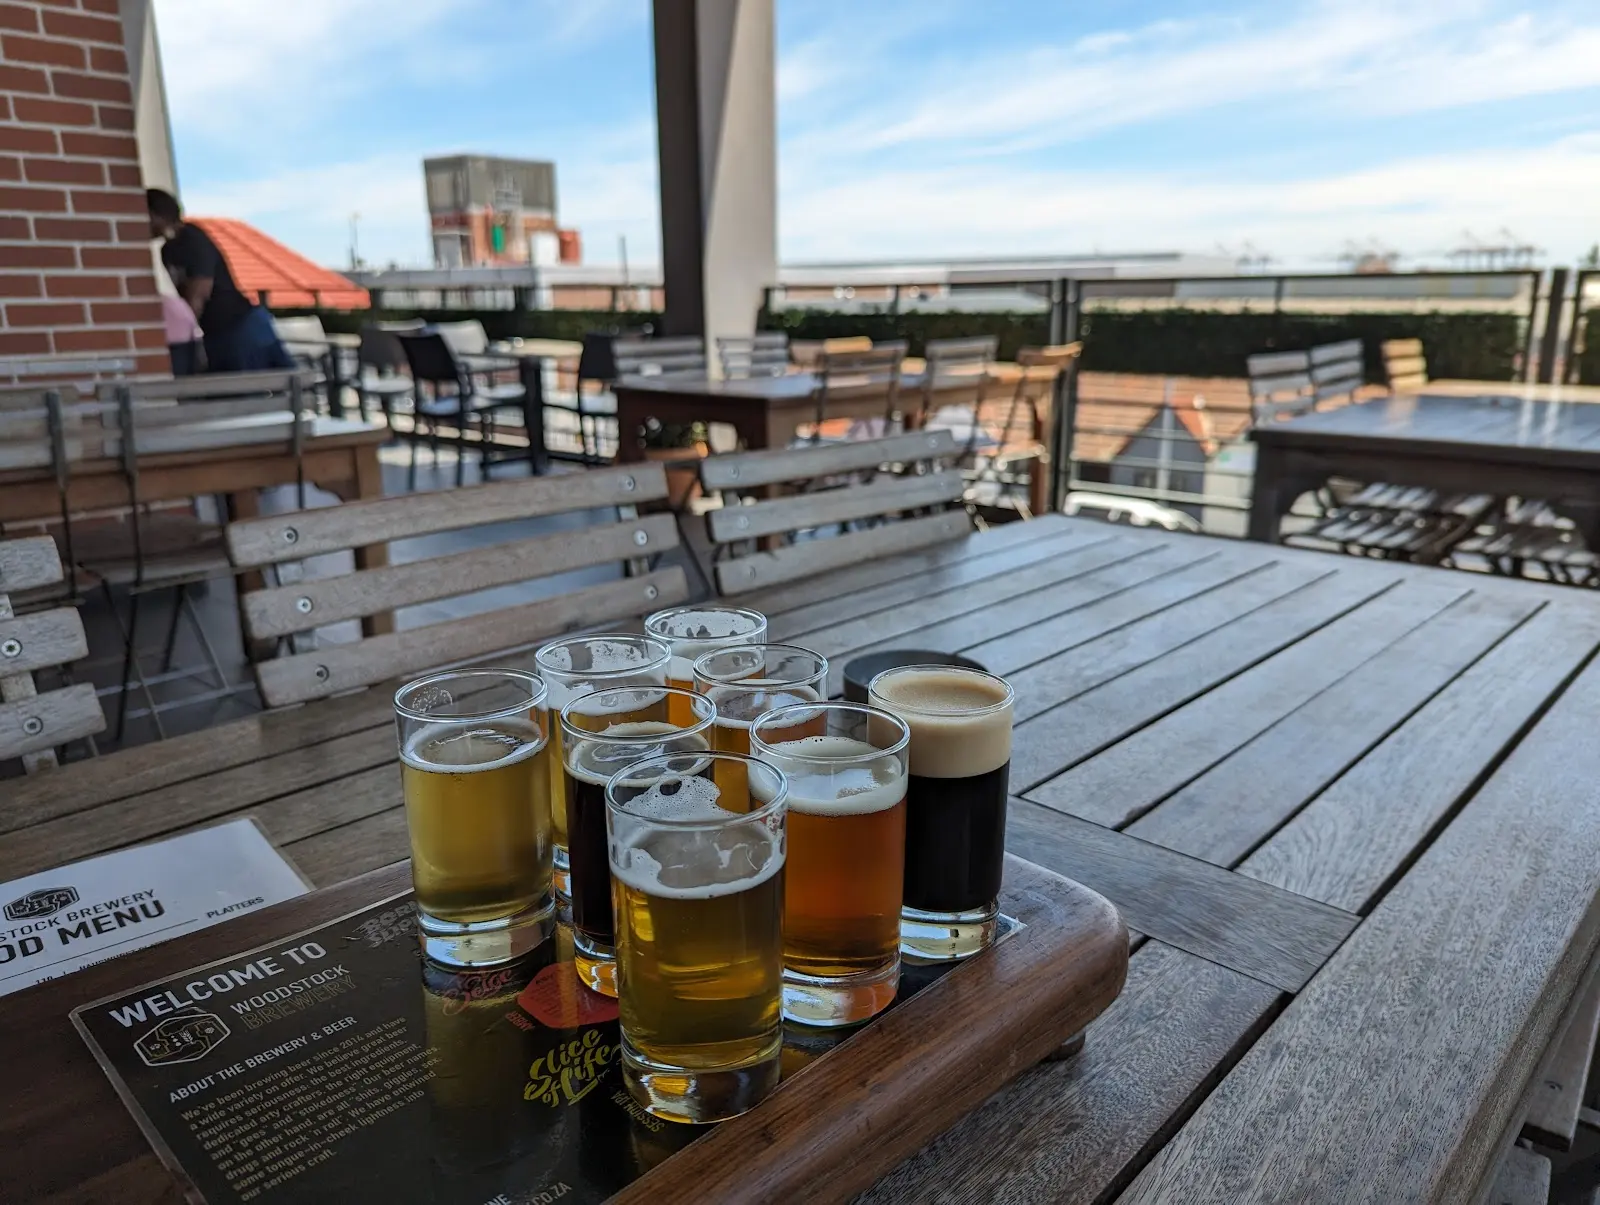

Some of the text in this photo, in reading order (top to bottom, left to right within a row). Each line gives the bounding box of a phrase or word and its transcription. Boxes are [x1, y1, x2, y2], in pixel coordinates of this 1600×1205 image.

[0, 889, 156, 942] STOCK BREWERY
[0, 936, 44, 964] OD
[57, 899, 166, 945] MENU
[206, 896, 265, 919] PLATTERS
[108, 942, 328, 1028] WELCOME TO
[230, 963, 351, 1015] WOODSTOCK
[240, 973, 357, 1031] BREWERY
[169, 1016, 357, 1103] ABOUT THE BREWERY & BEER
[189, 1123, 198, 1131] a
[198, 1109, 226, 1125] wide
[226, 1091, 263, 1112] variety
[265, 1085, 279, 1094] on
[305, 1065, 324, 1075] We
[323, 1048, 360, 1068] believe
[360, 1035, 386, 1053] great
[384, 1026, 407, 1039] beer
[215, 1089, 244, 1105] been
[243, 1069, 289, 1092] brewing
[286, 1058, 311, 1072] beer
[312, 1046, 340, 1061] since
[339, 1034, 364, 1049] 2014
[364, 1025, 383, 1038] and
[381, 1017, 406, 1029] have
[523, 1028, 603, 1101] Slice
[541, 1044, 613, 1108] of Life
[195, 1114, 243, 1140] requires
[309, 1075, 327, 1085] the
[327, 1063, 352, 1077] best
[203, 1118, 258, 1150] dedicated
[259, 1108, 280, 1123] arty
[324, 1080, 343, 1091] the
[343, 1067, 369, 1082] right
[210, 1143, 233, 1160] and
[272, 1114, 293, 1130] and
[362, 1073, 381, 1085] Our
[381, 1061, 405, 1076] beer
[217, 1159, 234, 1170] on
[233, 1148, 254, 1161] the
[254, 1133, 283, 1151] other
[316, 1109, 335, 1120] are
[336, 1100, 350, 1111] all
[225, 1159, 259, 1180] drugs
[261, 1146, 283, 1162] and
[283, 1134, 310, 1151] rock
[347, 1107, 366, 1117] We
[365, 1094, 391, 1109] have
[392, 1070, 436, 1096] entwined
[622, 1102, 666, 1133] SESSION
[232, 1170, 265, 1191] some
[357, 1100, 405, 1126] lightness
[403, 1090, 424, 1102] into
[240, 1187, 261, 1202] our
[263, 1164, 306, 1189] serious
